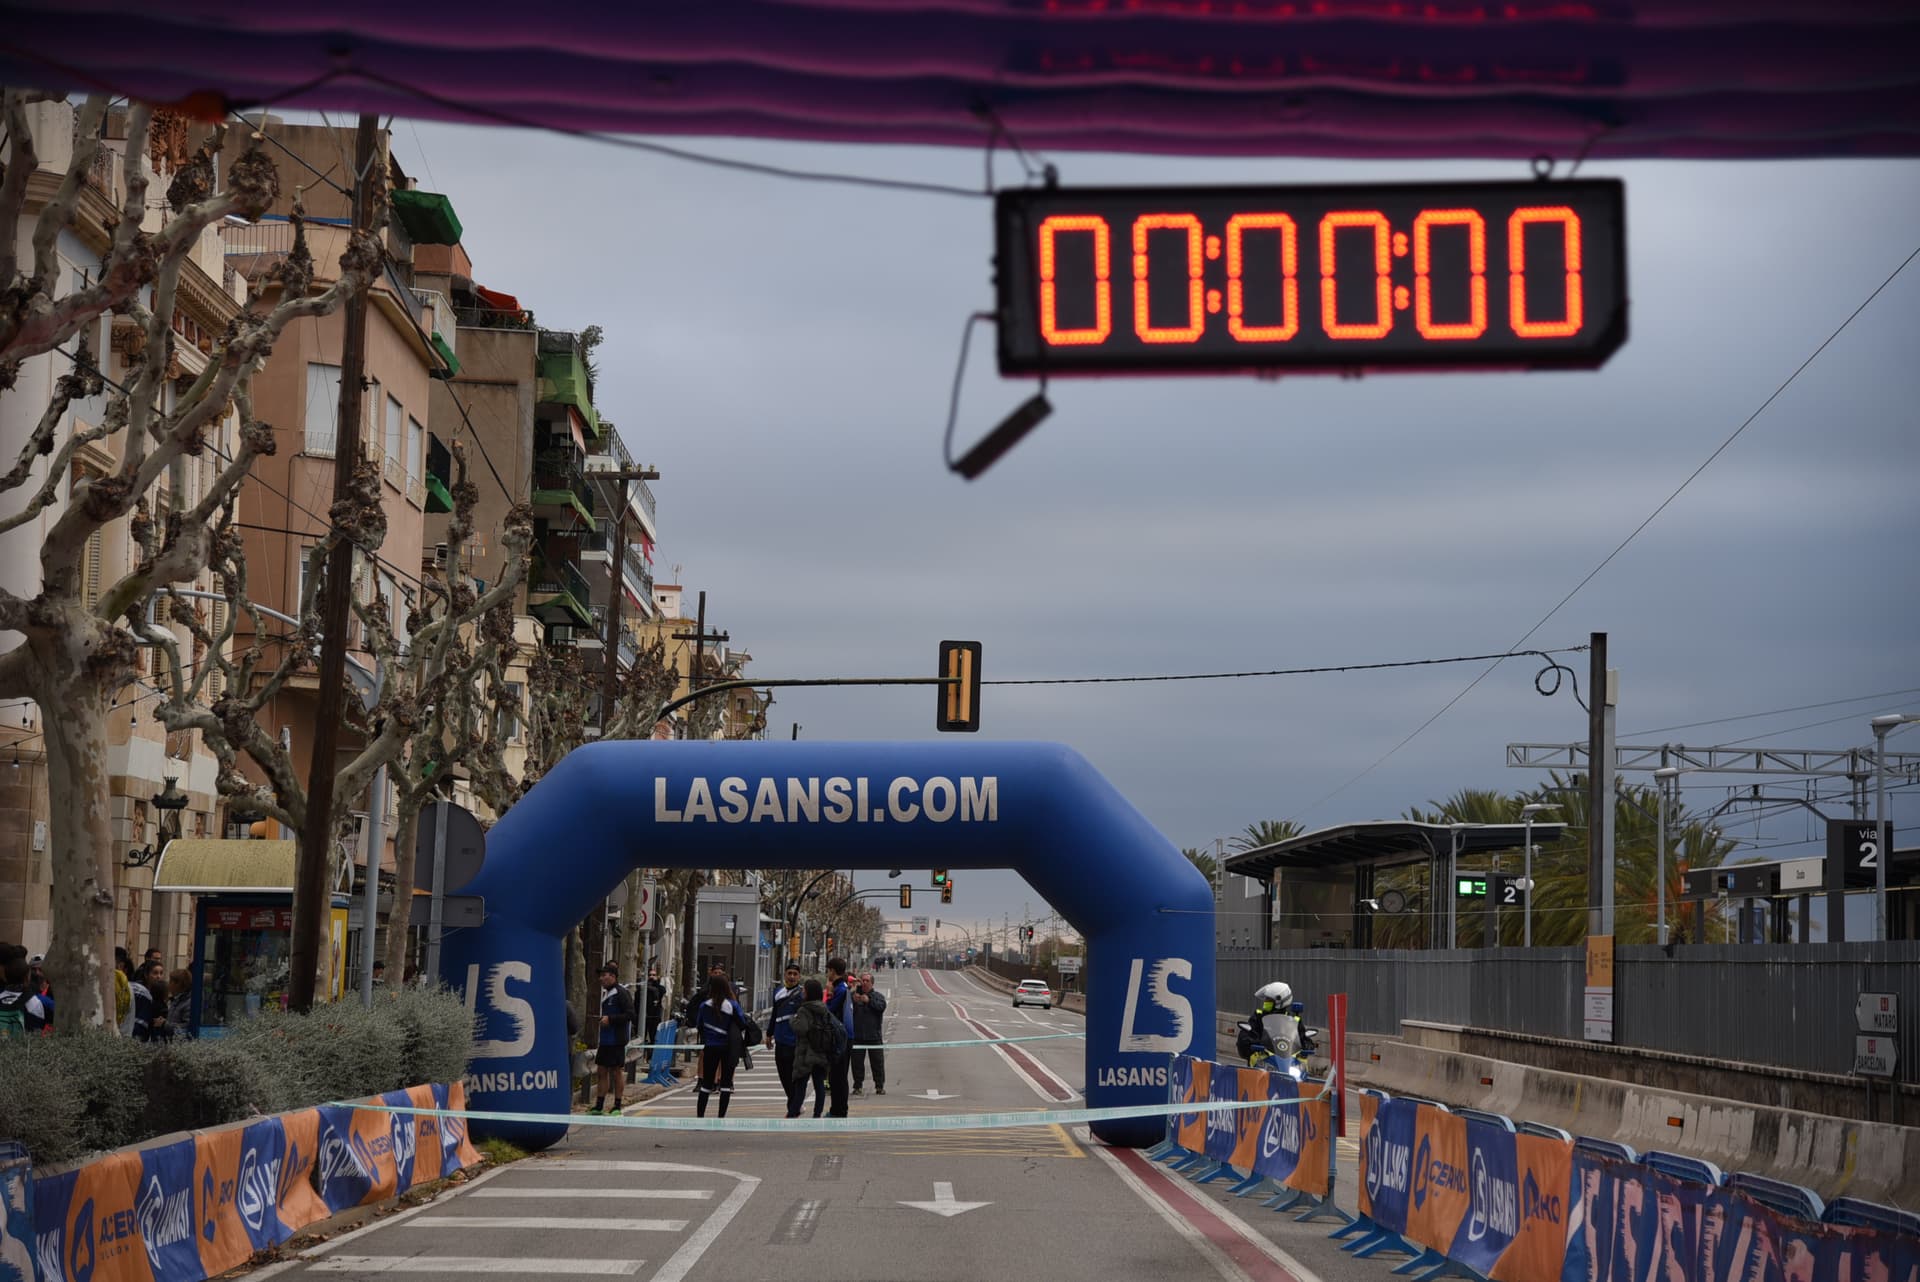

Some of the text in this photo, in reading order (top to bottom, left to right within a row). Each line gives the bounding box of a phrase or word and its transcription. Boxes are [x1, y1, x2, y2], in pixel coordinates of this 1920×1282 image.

[1038, 206, 1583, 346] 00:00:00
[654, 776, 998, 823] LASANSI.COM
[1858, 828, 1877, 840] via
[1858, 842, 1877, 868] 2
[1503, 886, 1517, 903] 2
[1118, 957, 1194, 1053] LS
[468, 1070, 559, 1093] ANSI.COM
[1098, 1066, 1168, 1087] LASANS
